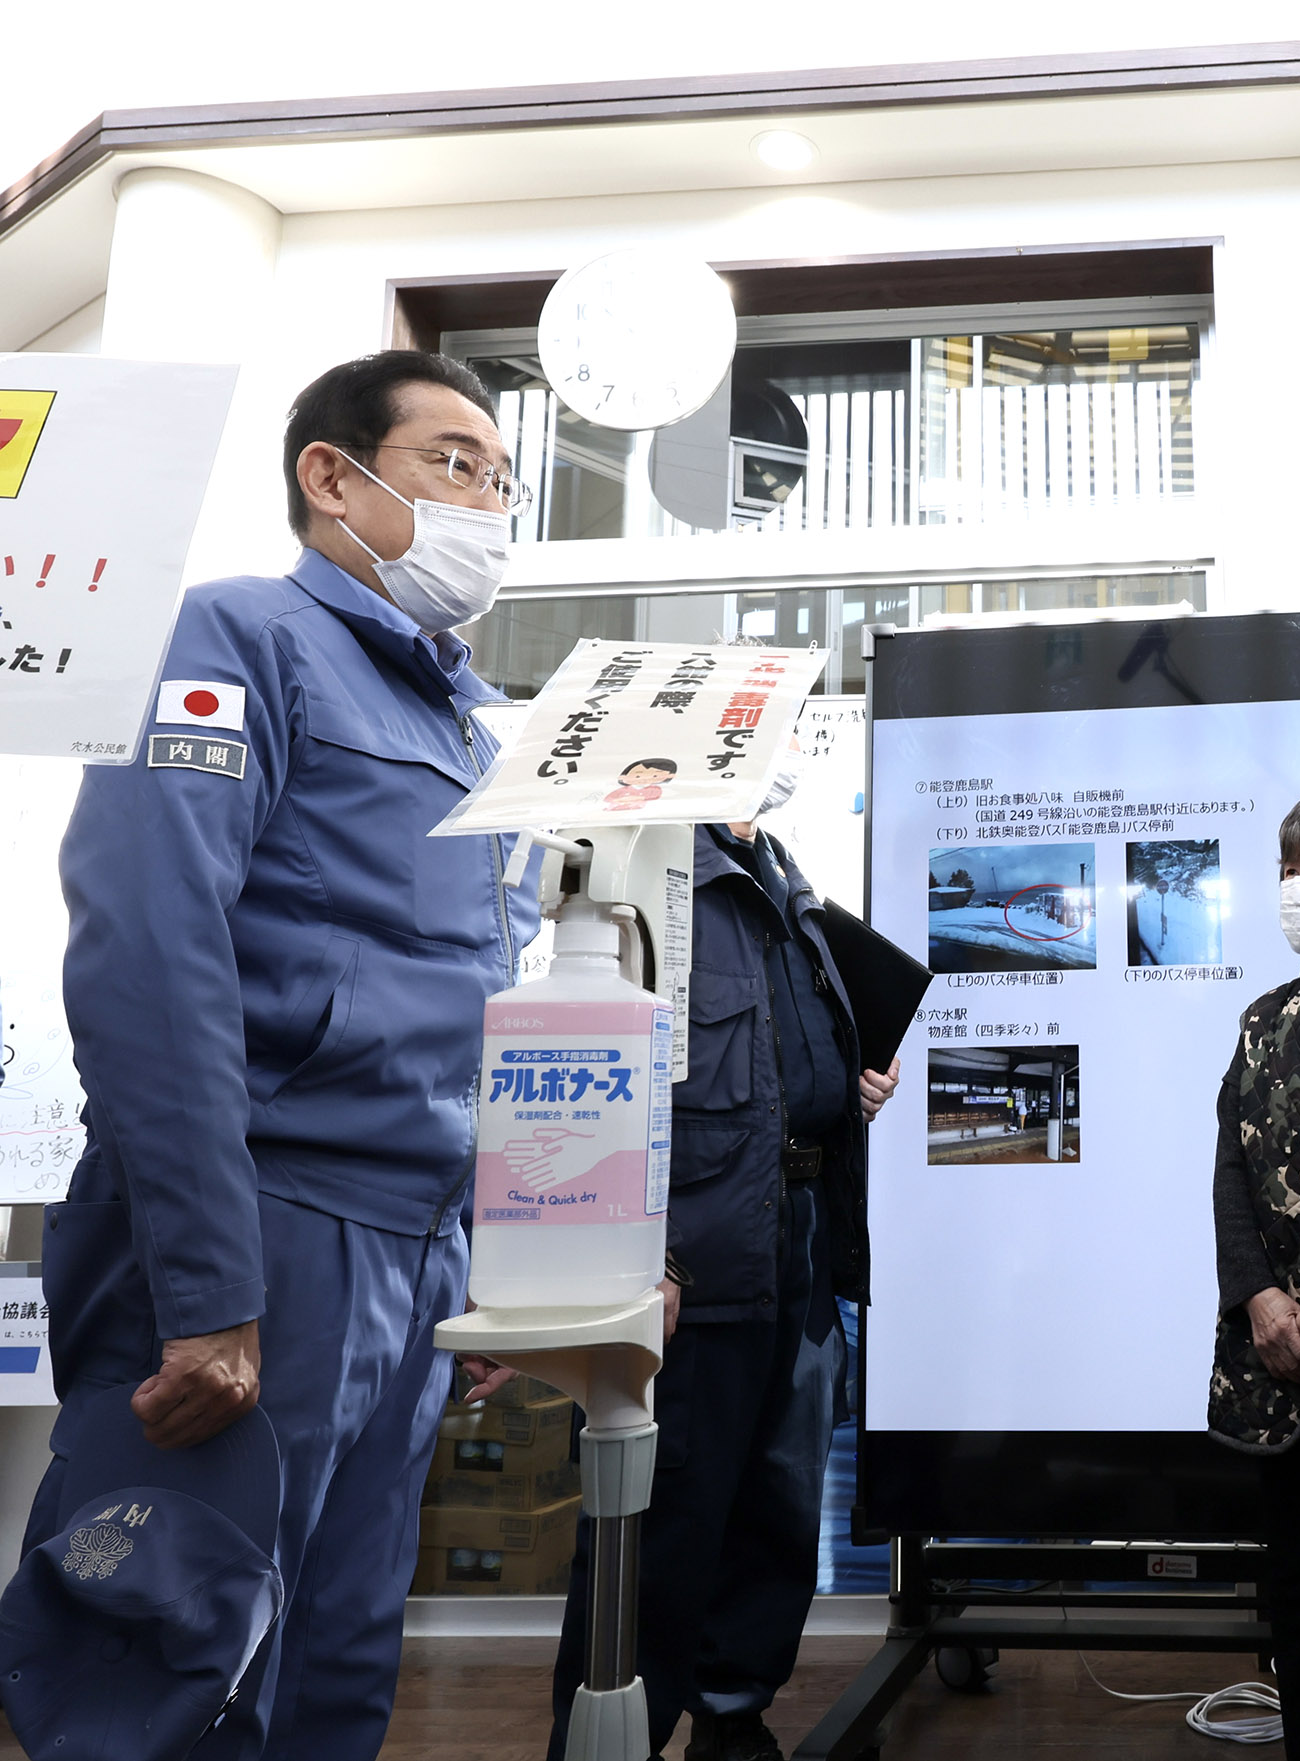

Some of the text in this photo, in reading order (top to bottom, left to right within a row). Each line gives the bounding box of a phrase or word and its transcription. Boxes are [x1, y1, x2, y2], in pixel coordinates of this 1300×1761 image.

[577, 363, 591, 382] 8
[602, 384, 615, 403] 7
[0, 643, 72, 674] た！
[537, 650, 653, 786] ご使用ください。
[809, 707, 866, 723] セルフ洗
[70, 740, 128, 755] 穴水公民館
[168, 741, 230, 767] 内閣
[936, 788, 1125, 809] （上り） 旧お食事処八味 自販機前
[975, 809, 1007, 824] （国道
[1009, 809, 1034, 822] 249
[936, 819, 1174, 841] （下り） 北鉄奥能登バス「能登鹿島」バス停前
[946, 971, 1065, 988] （上りのバス停車位置）
[1124, 966, 1244, 983] （下りのバス停車位置）
[489, 1067, 634, 1103] アルボナース
[0, 1135, 82, 1168] れる家
[14, 1172, 71, 1193] しめ
[507, 1190, 597, 1206] Clean & Quick dry
[0, 1302, 50, 1320] 協議会
